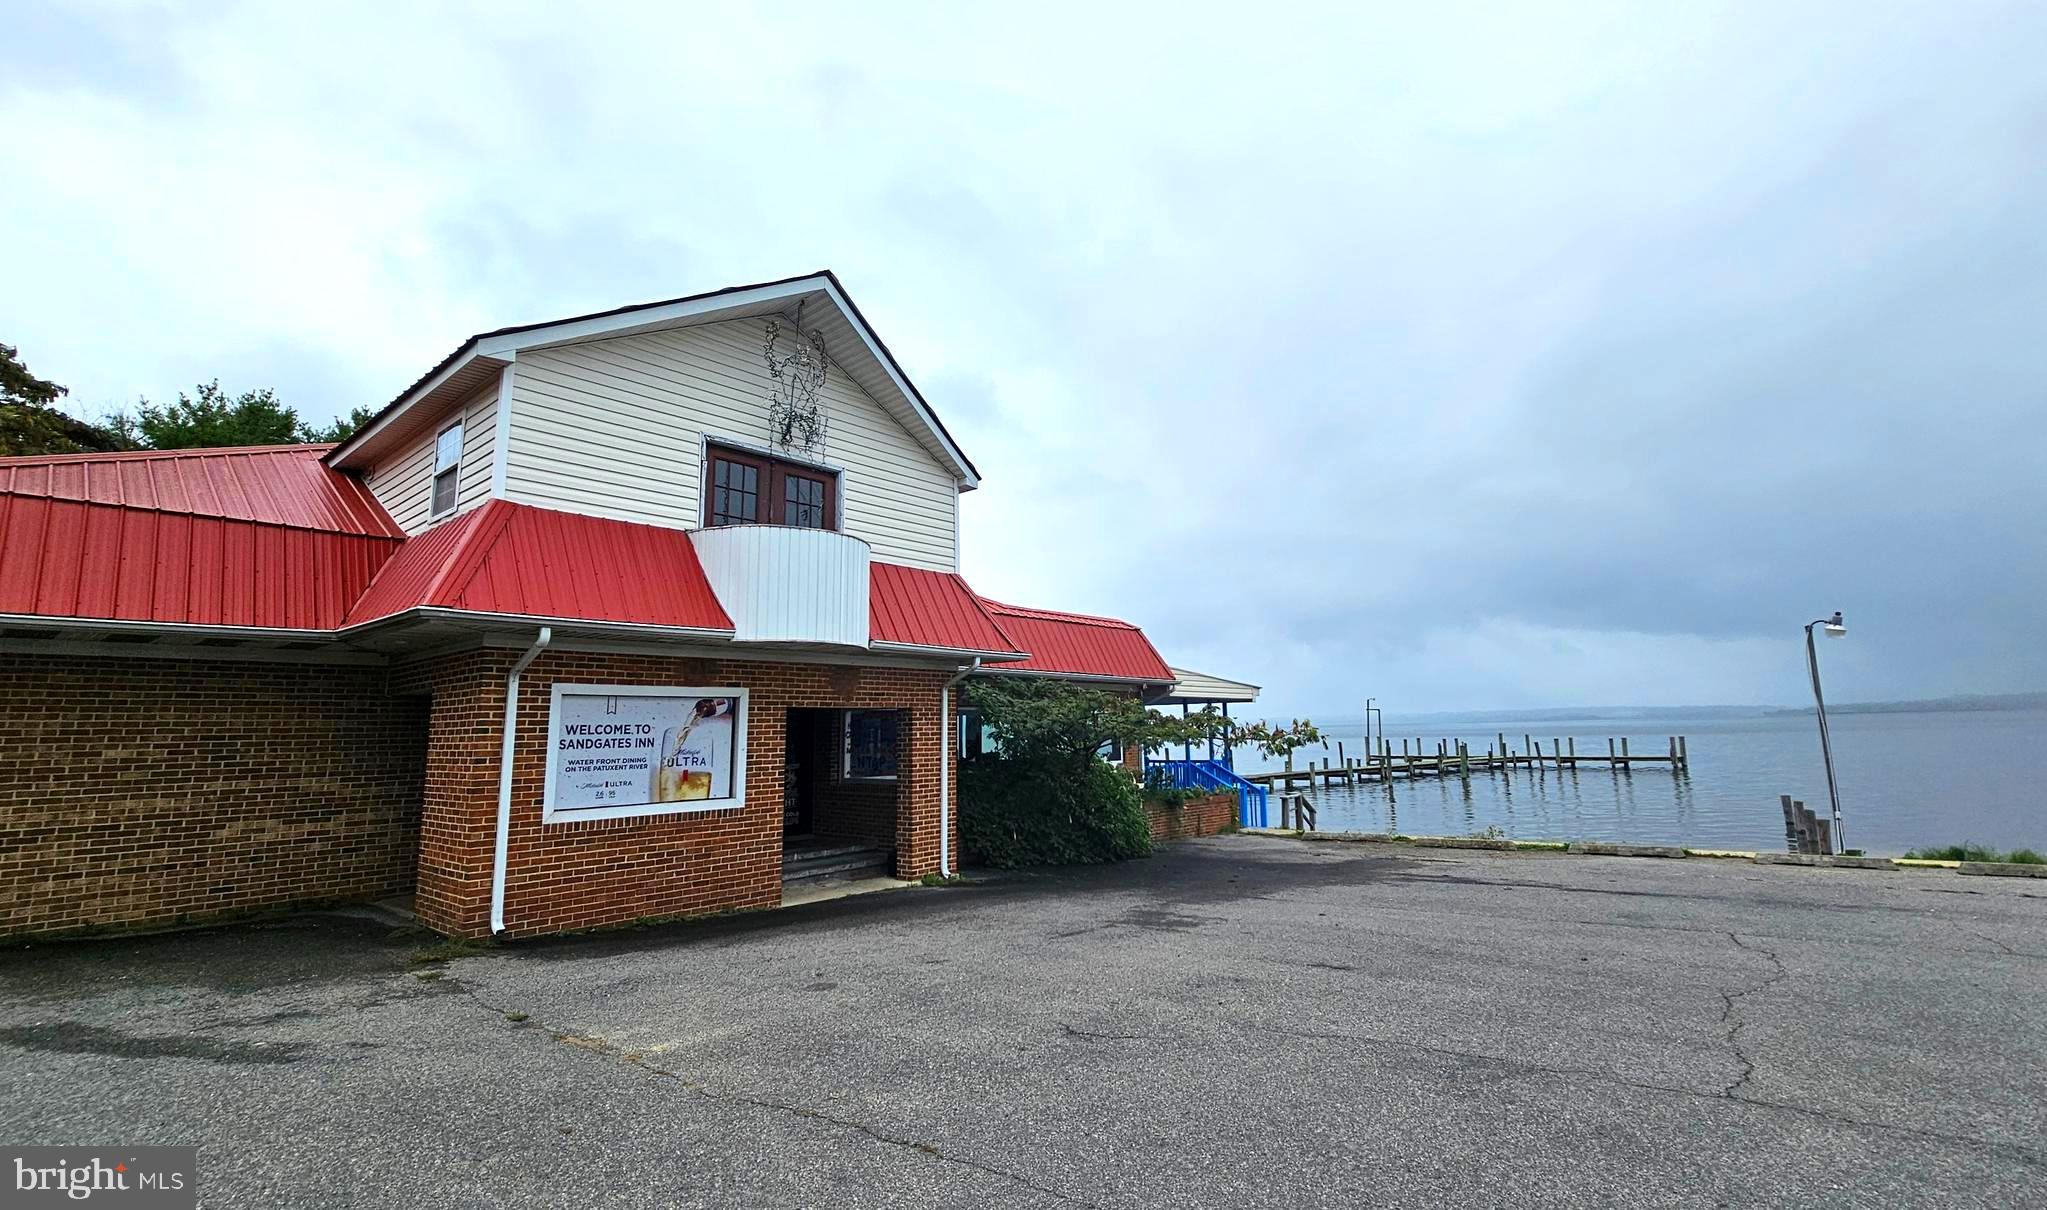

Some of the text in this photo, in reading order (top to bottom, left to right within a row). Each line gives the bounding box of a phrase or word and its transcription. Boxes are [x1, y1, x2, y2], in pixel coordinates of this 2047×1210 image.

[565, 723, 651, 736] WELCOME TO
[559, 737, 655, 750] SANDGATES INN
[667, 757, 706, 767] ULTRA
